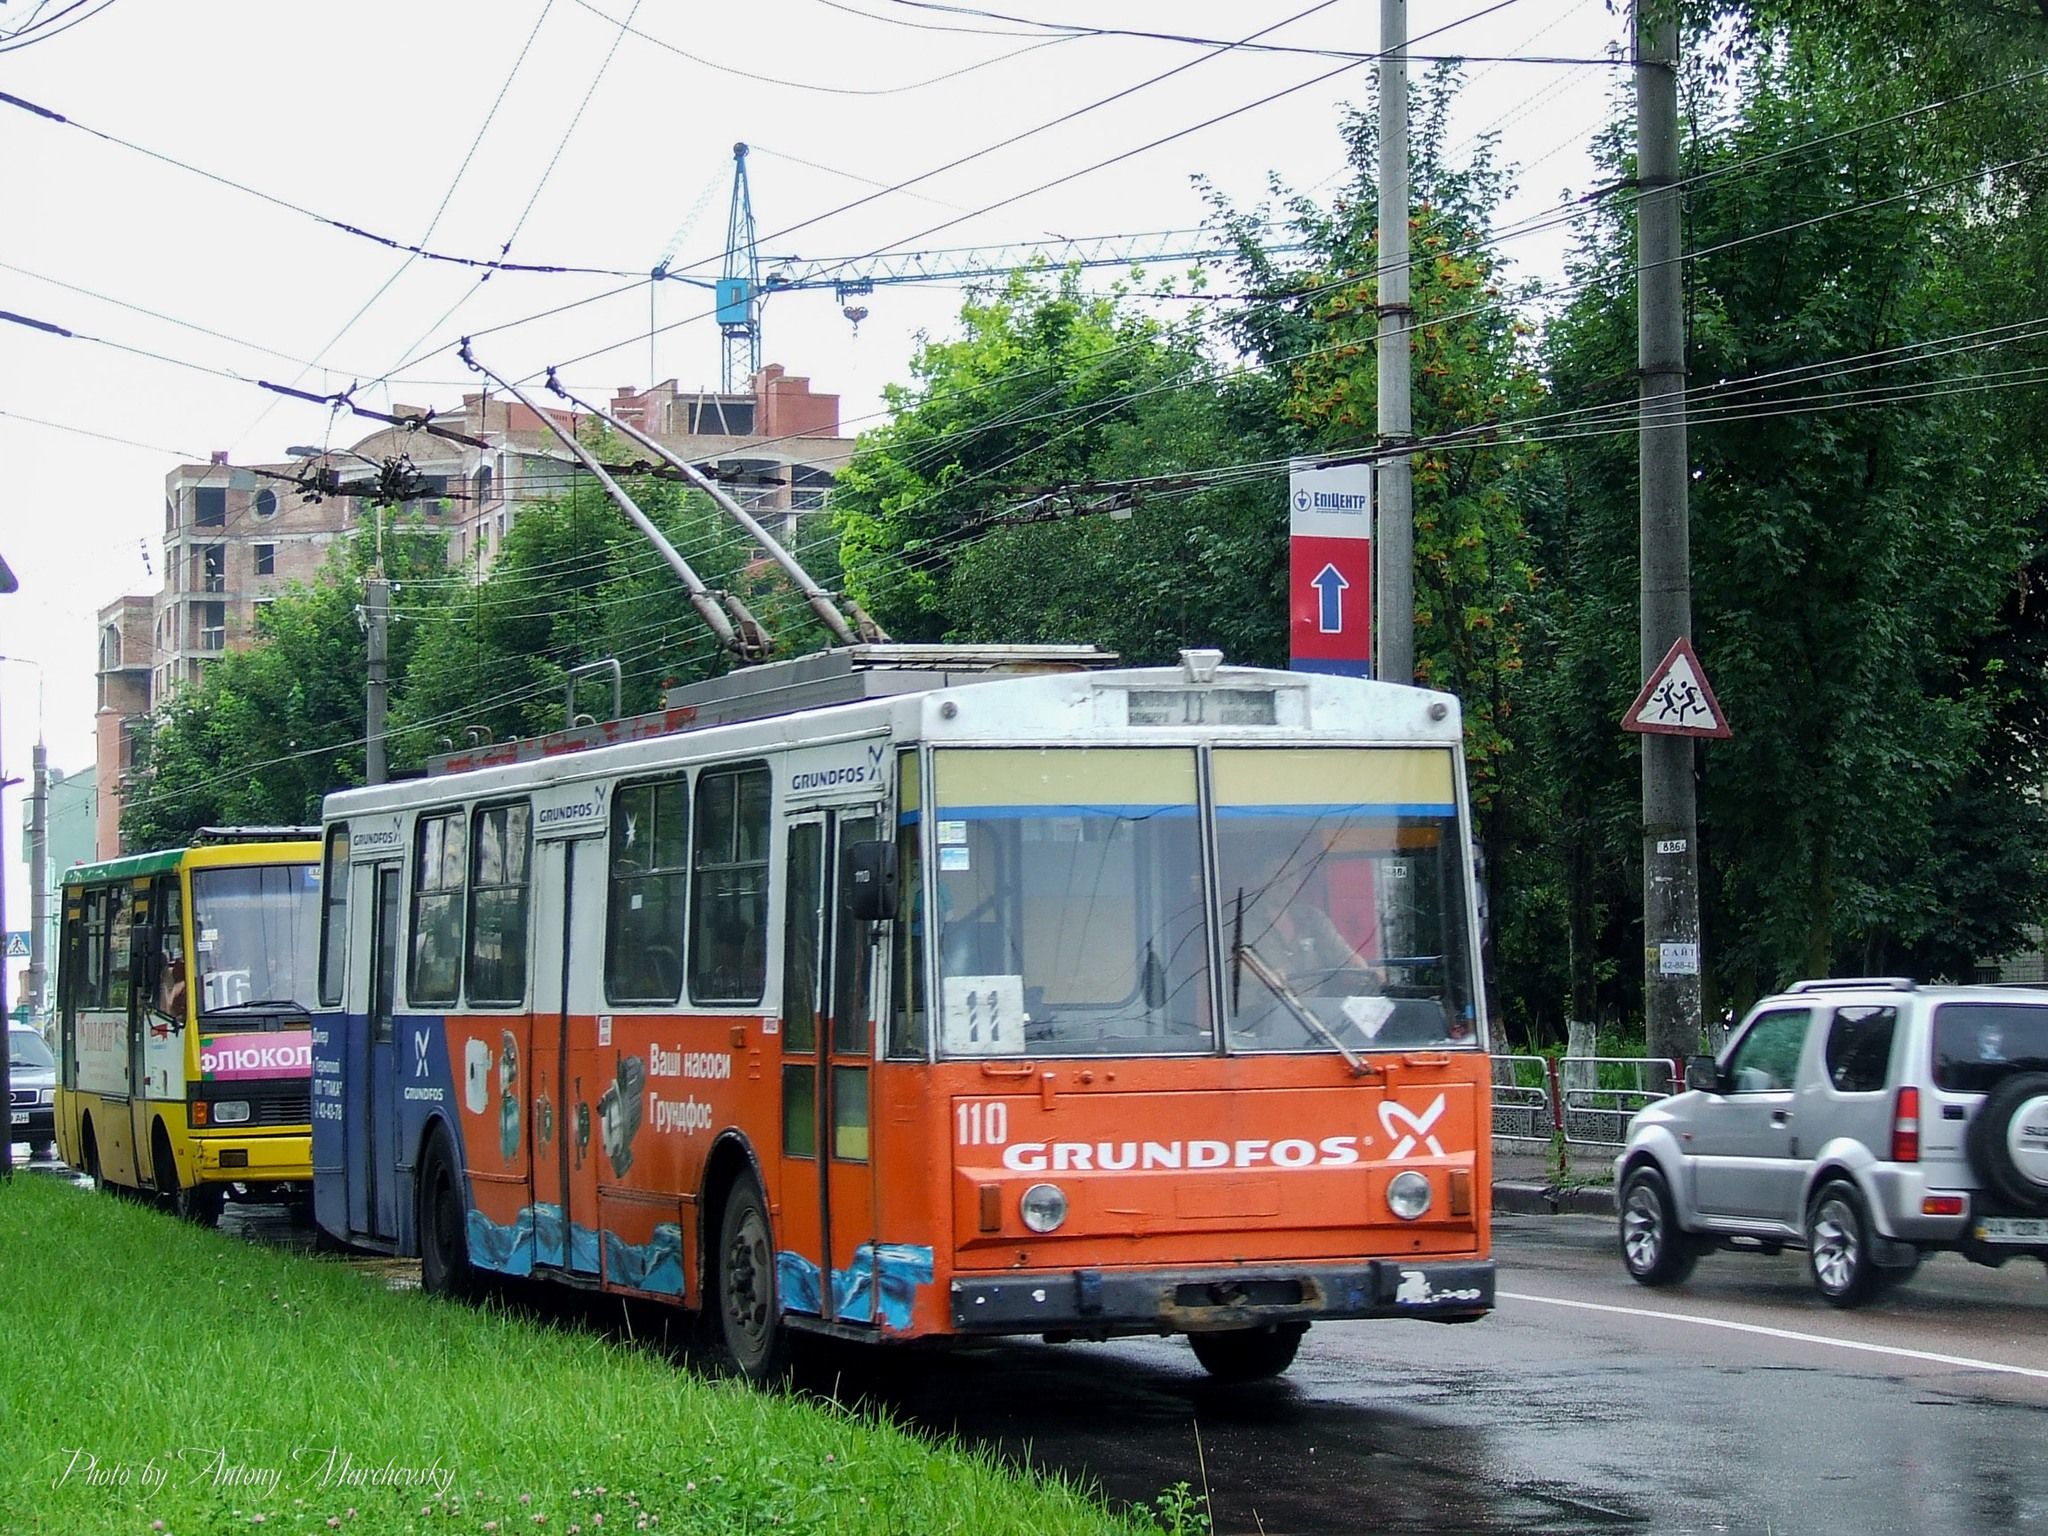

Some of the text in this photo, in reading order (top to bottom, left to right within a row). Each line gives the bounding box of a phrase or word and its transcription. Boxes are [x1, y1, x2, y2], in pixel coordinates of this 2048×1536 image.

[1314, 492, 1366, 511] ЕПІЦЕНТР
[791, 766, 865, 790] GRUNDFOS
[539, 802, 593, 823] GRUNDFOS
[353, 830, 393, 847] GRUNDFOS
[966, 990, 999, 1042] 11
[650, 1043, 731, 1080] Ваші насоси
[404, 1086, 445, 1101] GRUNDFOS
[650, 1092, 713, 1136] Грундфос
[957, 1102, 1008, 1146] 110
[1001, 1136, 1360, 1171] GRUNDFOS
